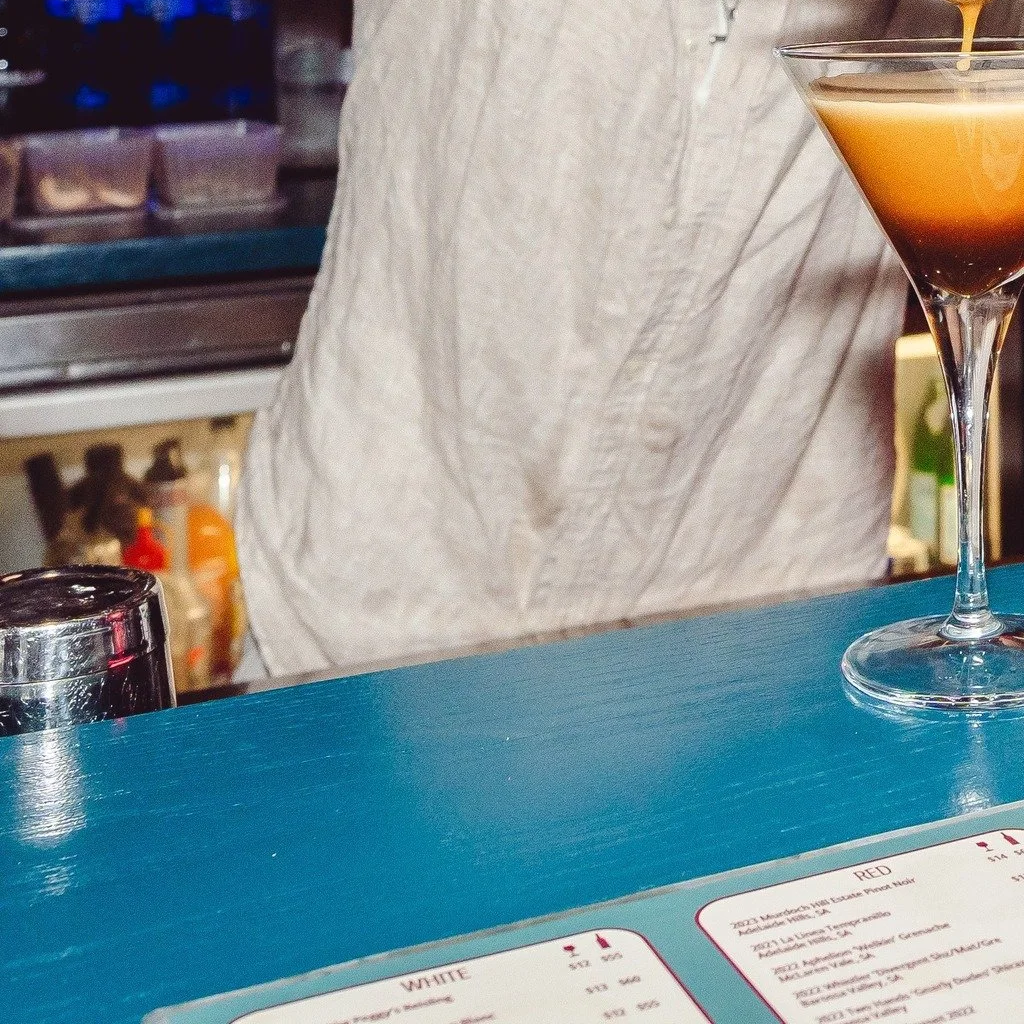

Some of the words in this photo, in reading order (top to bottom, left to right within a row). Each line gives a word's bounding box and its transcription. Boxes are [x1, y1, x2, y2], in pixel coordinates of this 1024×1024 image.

[987, 853, 1008, 862] $14
[853, 865, 892, 881] RED
[830, 892, 863, 904] Estate
[863, 884, 893, 895] Pinot
[892, 877, 915, 887] Noir
[401, 969, 469, 992] WHITE
